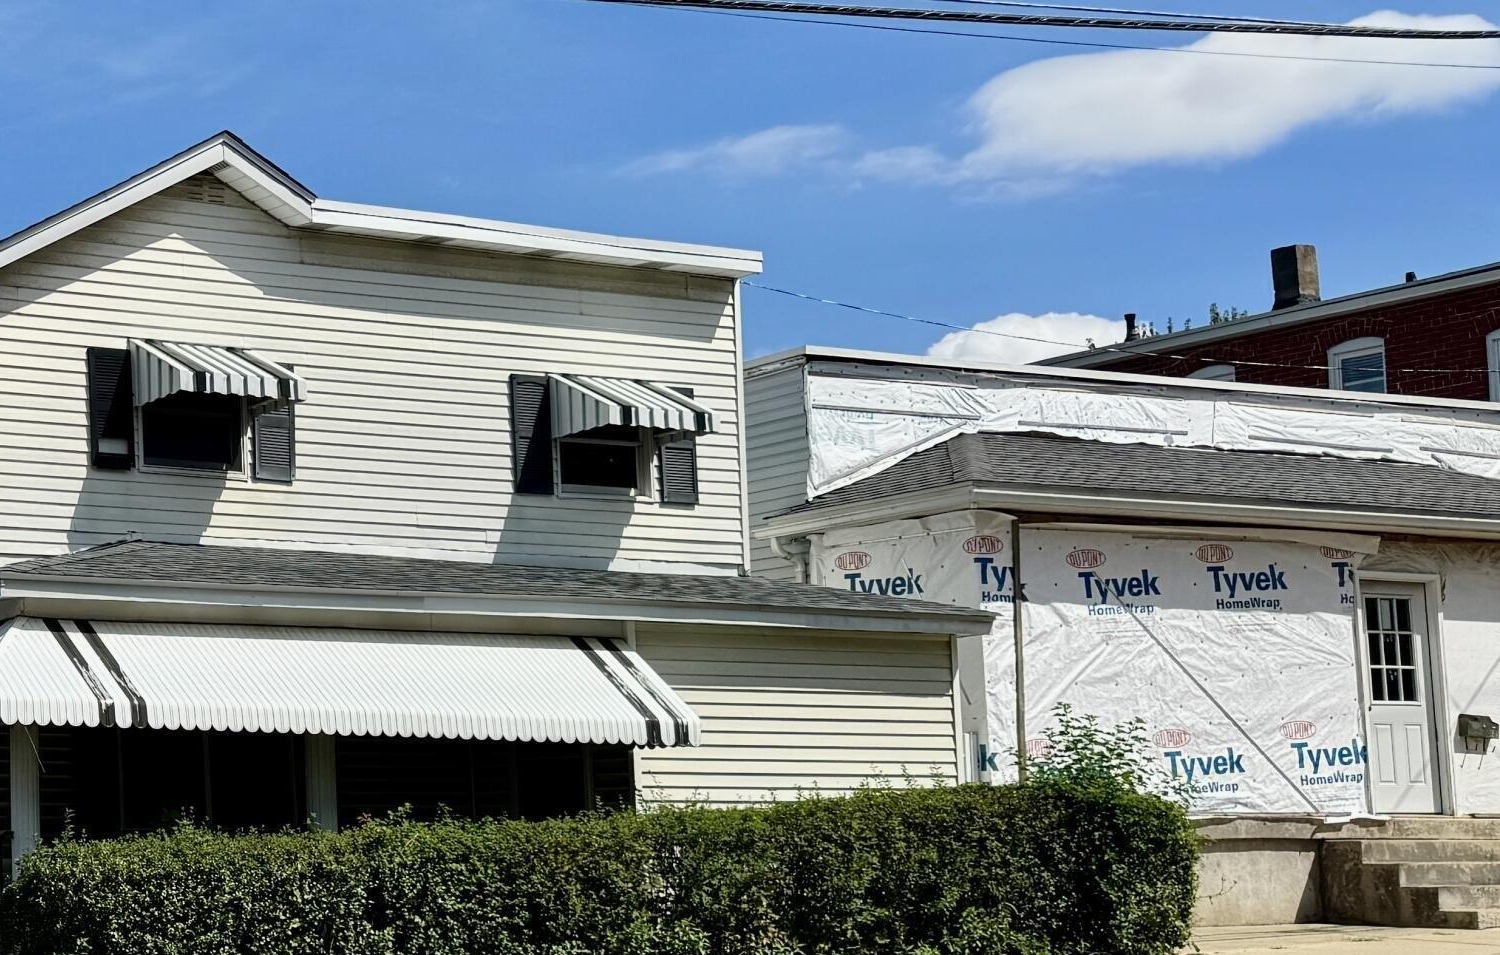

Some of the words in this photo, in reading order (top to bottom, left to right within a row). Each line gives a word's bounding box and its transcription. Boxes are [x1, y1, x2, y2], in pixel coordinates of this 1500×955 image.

[1077, 569, 1161, 604] Tyvek
[1207, 564, 1289, 598] Tyvek
[1216, 597, 1280, 610] HomeWrap
[1163, 747, 1246, 784] Tyvek
[1290, 738, 1368, 774] Tyvek
[1300, 770, 1363, 786] HomeWrap
